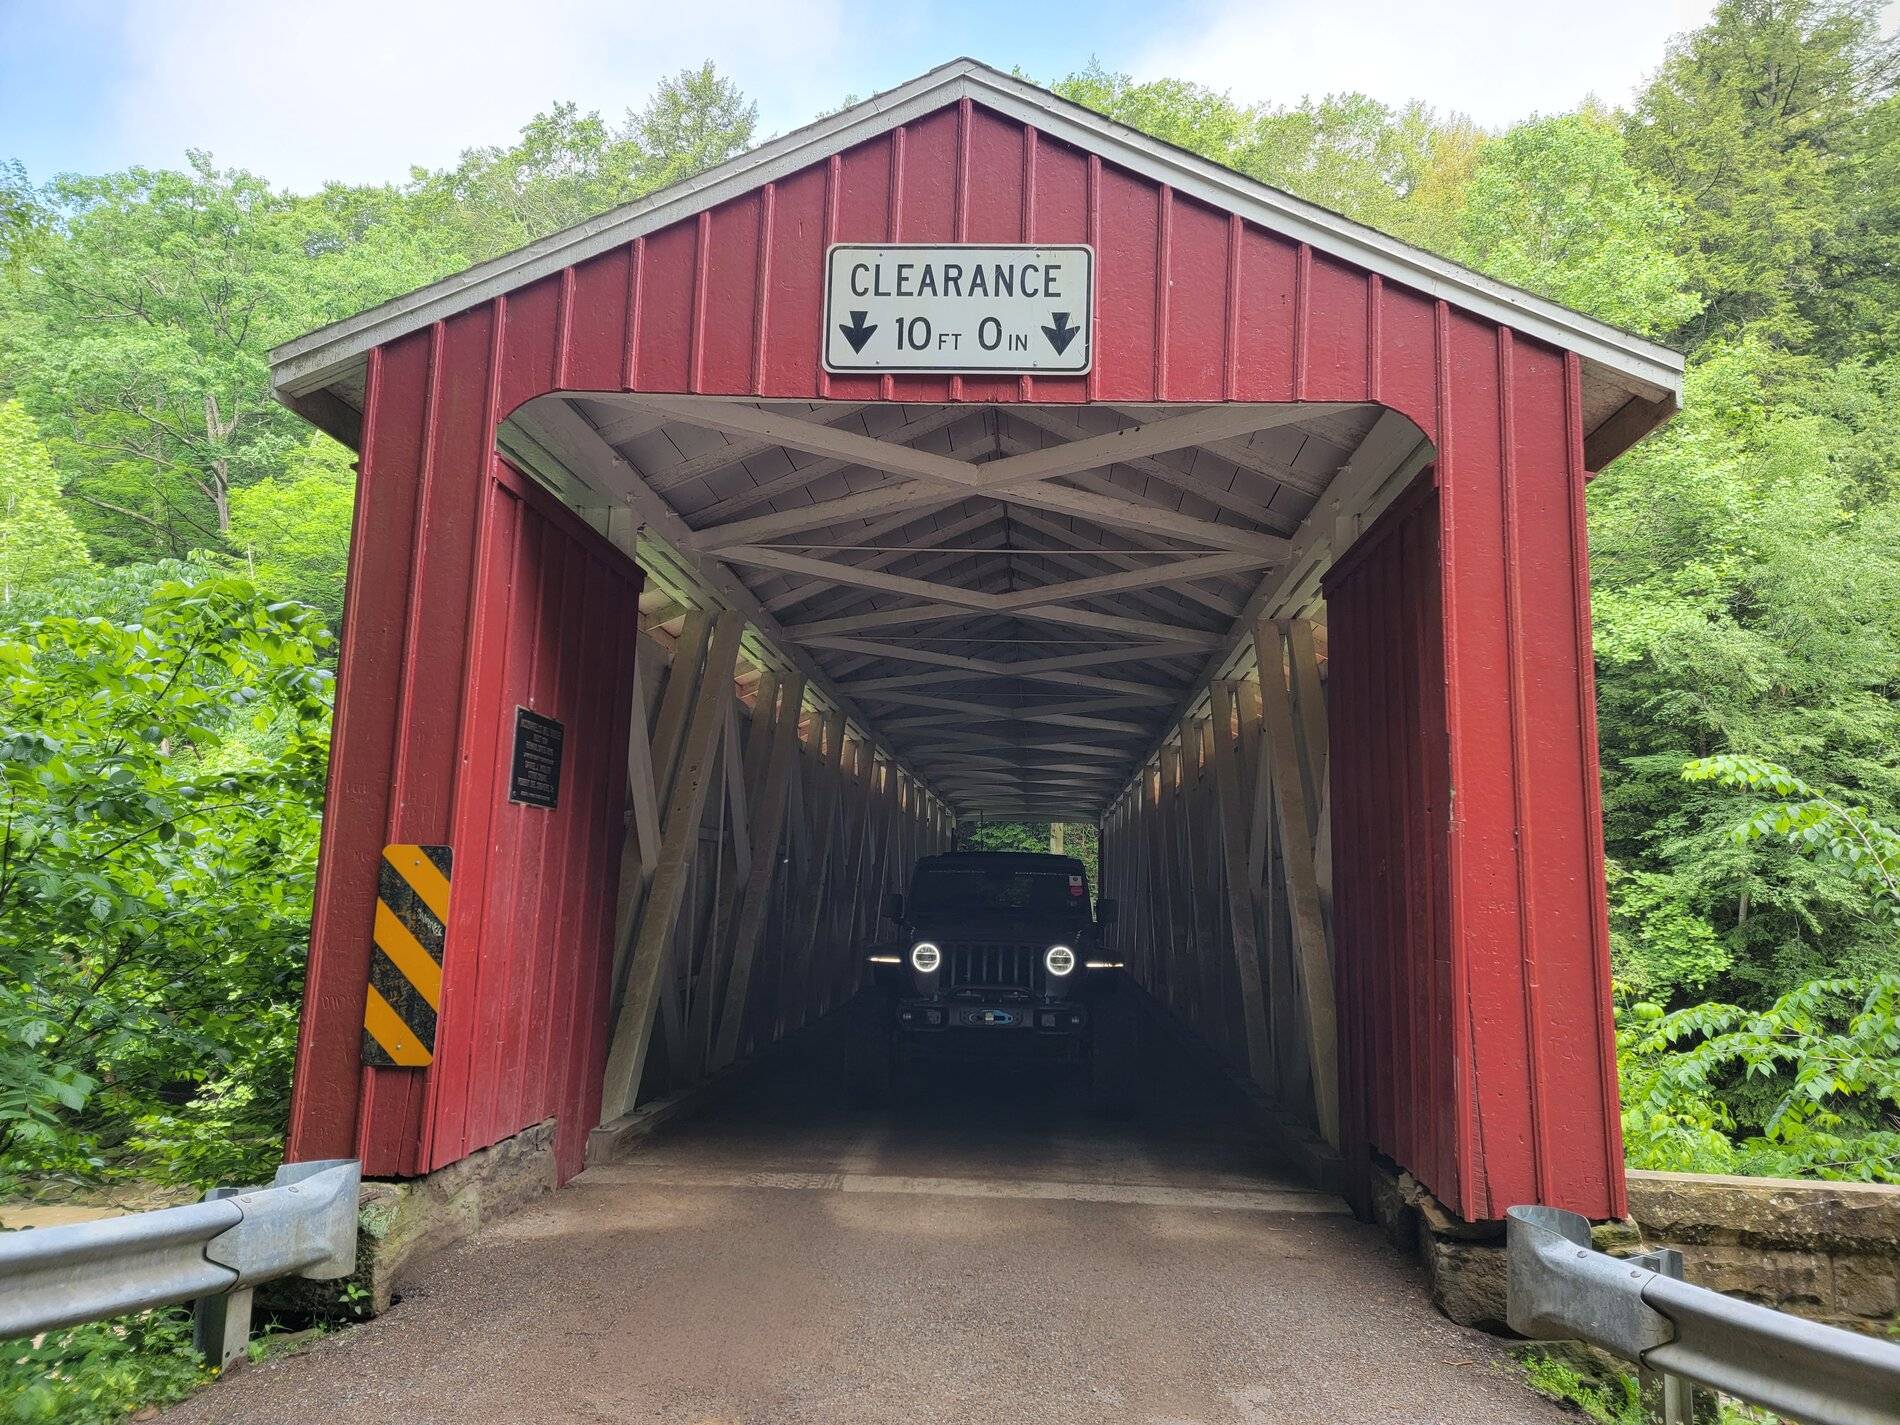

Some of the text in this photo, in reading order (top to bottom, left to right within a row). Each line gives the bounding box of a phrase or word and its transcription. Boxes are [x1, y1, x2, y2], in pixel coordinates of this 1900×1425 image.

[850, 263, 1062, 297] CLEARANCE
[895, 316, 932, 351] 10
[938, 333, 962, 350] FT
[1008, 334, 1028, 351] IN
